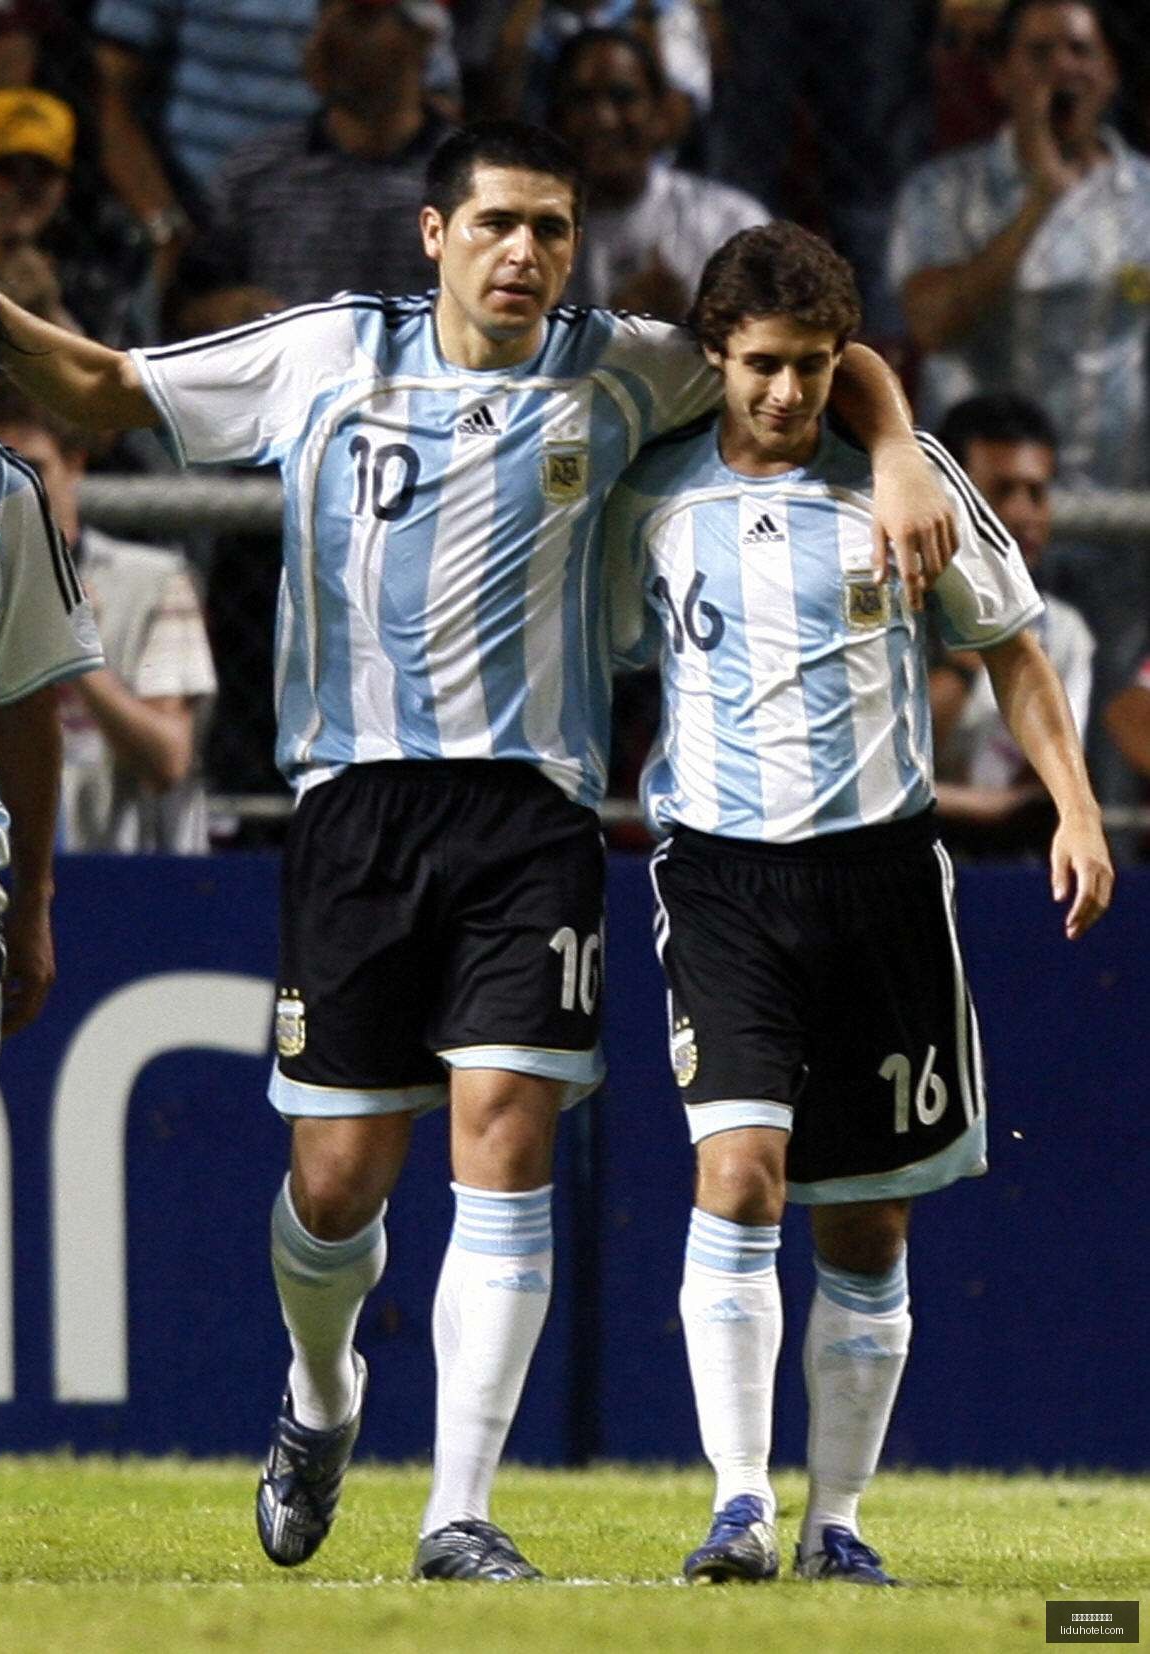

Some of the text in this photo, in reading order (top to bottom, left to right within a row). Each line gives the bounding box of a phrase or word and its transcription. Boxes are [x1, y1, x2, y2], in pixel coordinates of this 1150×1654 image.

[349, 435, 421, 521] 10
[652, 568, 725, 653] 16
[549, 926, 600, 1016] 10
[878, 1044, 948, 1133] 16
